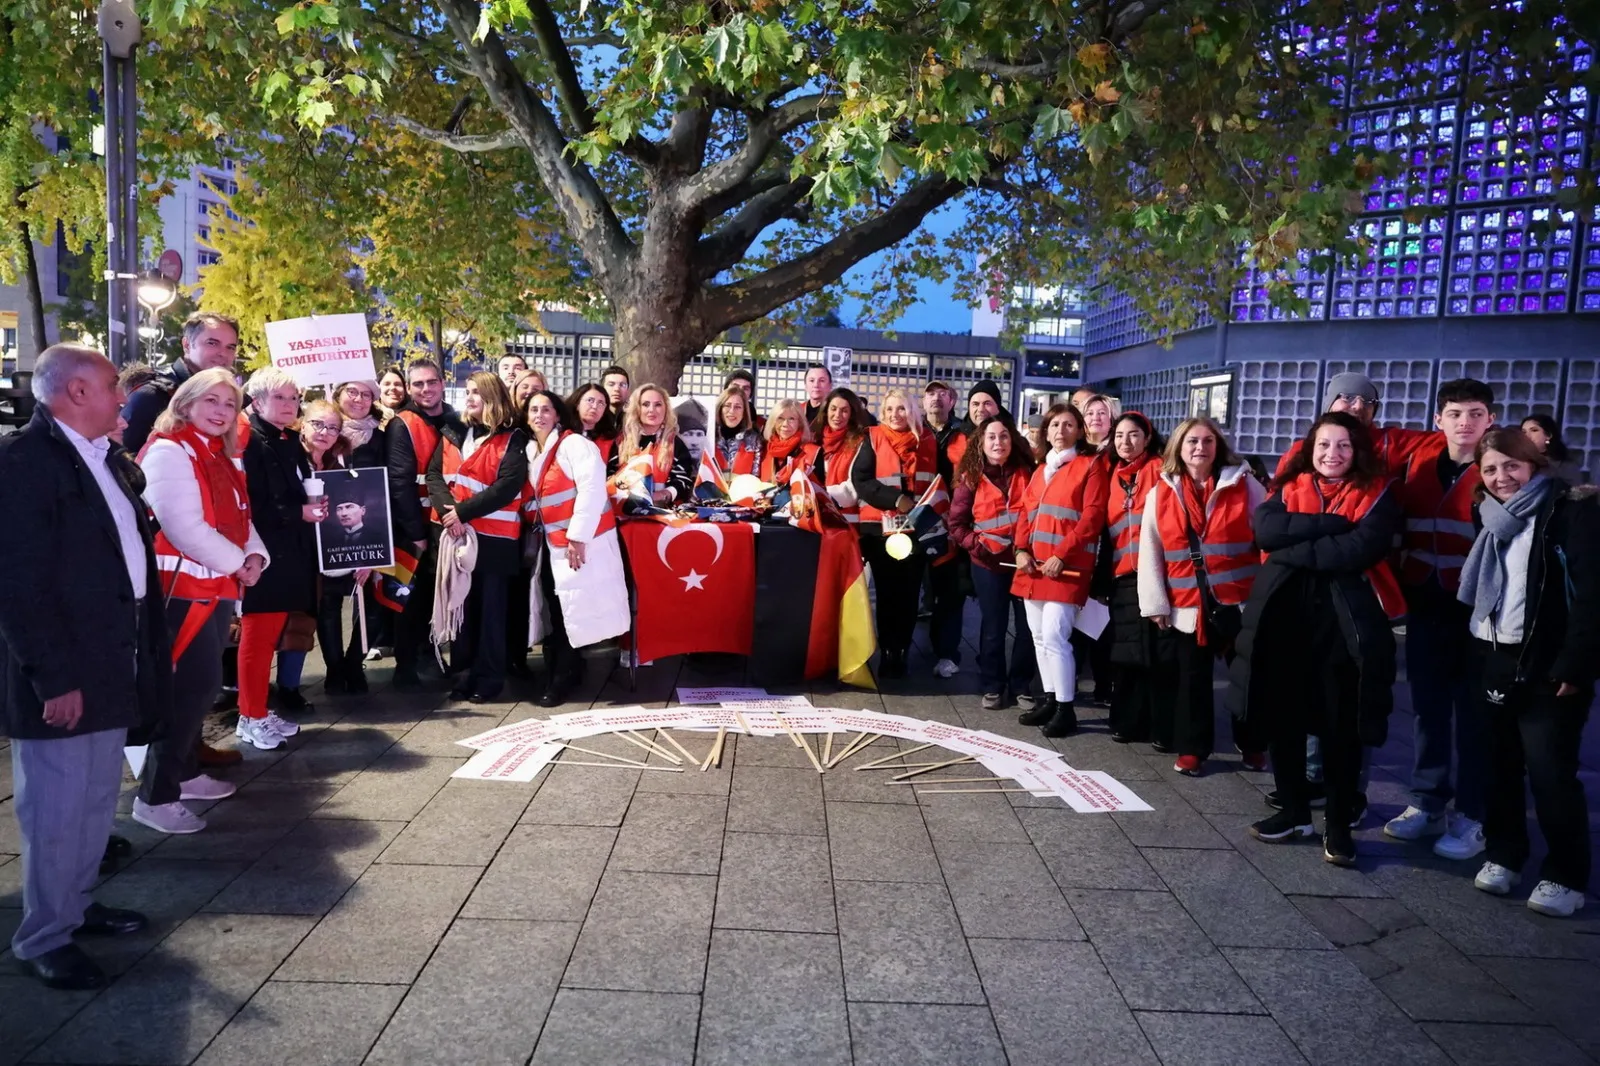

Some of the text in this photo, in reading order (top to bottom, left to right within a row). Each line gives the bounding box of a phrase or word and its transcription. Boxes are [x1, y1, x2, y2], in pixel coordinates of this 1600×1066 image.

[288, 336, 347, 351] YAŞASIN
[277, 348, 369, 368] CUMHURİYET
[828, 350, 845, 371] P
[328, 549, 385, 563] ATATÜRK
